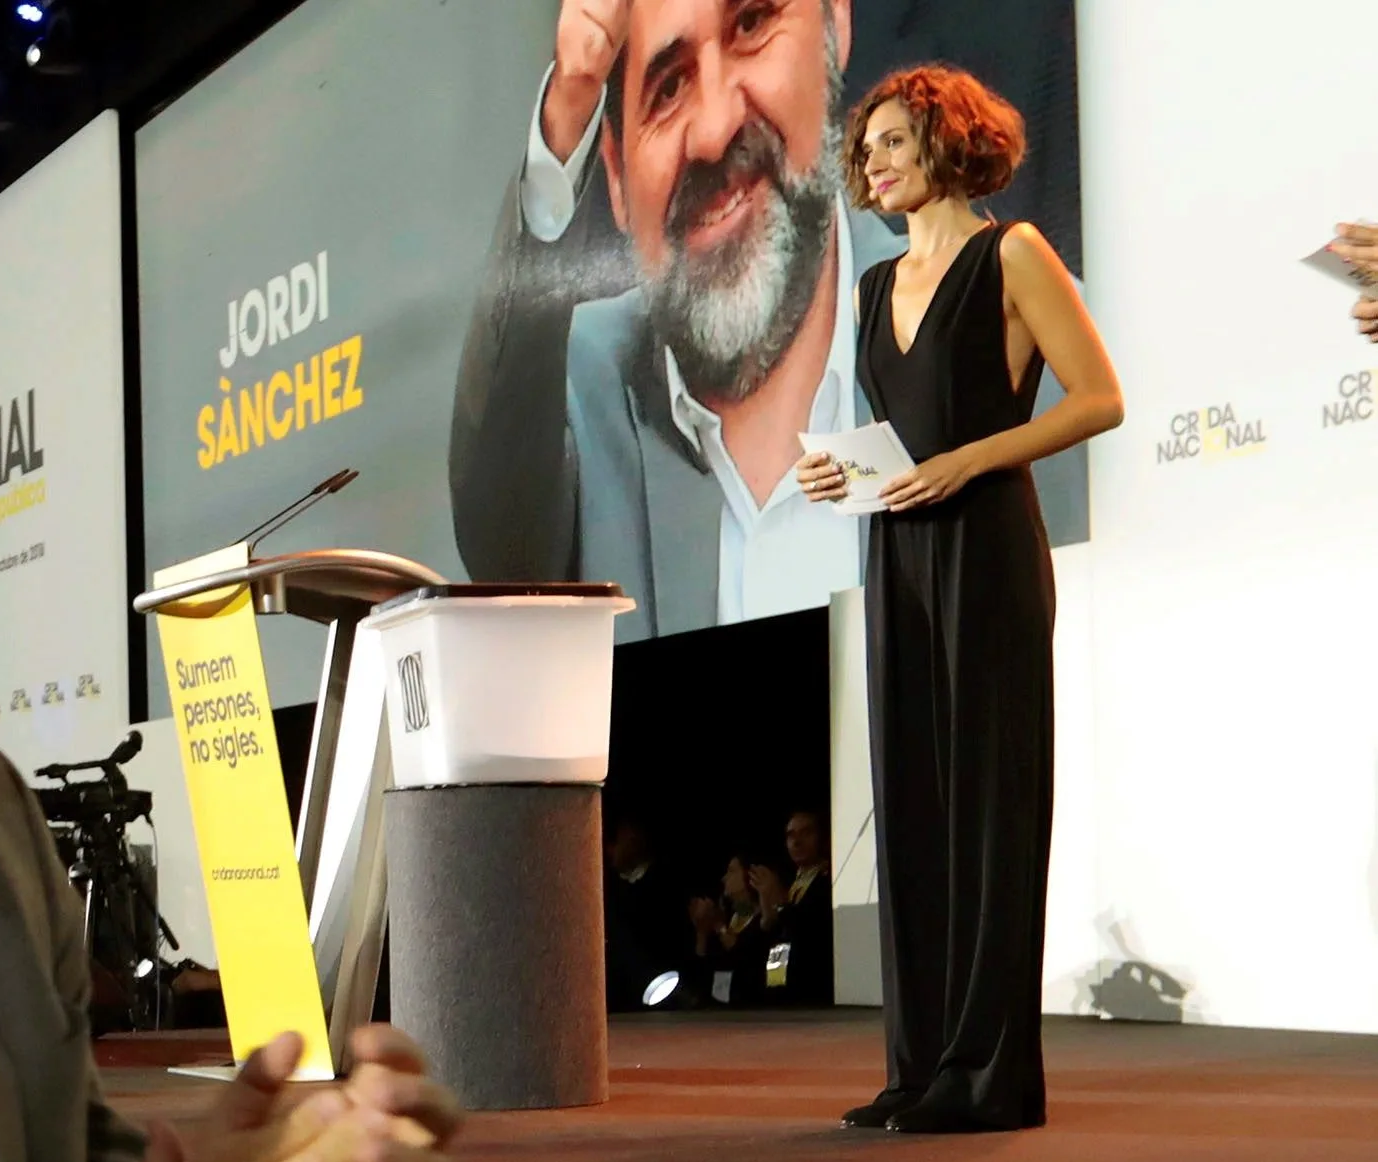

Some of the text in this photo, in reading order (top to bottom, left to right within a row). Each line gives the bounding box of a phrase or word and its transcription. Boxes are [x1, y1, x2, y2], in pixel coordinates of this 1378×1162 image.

[219, 250, 329, 369] JORDI
[176, 653, 237, 690] Sumem
[183, 690, 261, 735] persones,
[189, 727, 264, 769] no sigles.
